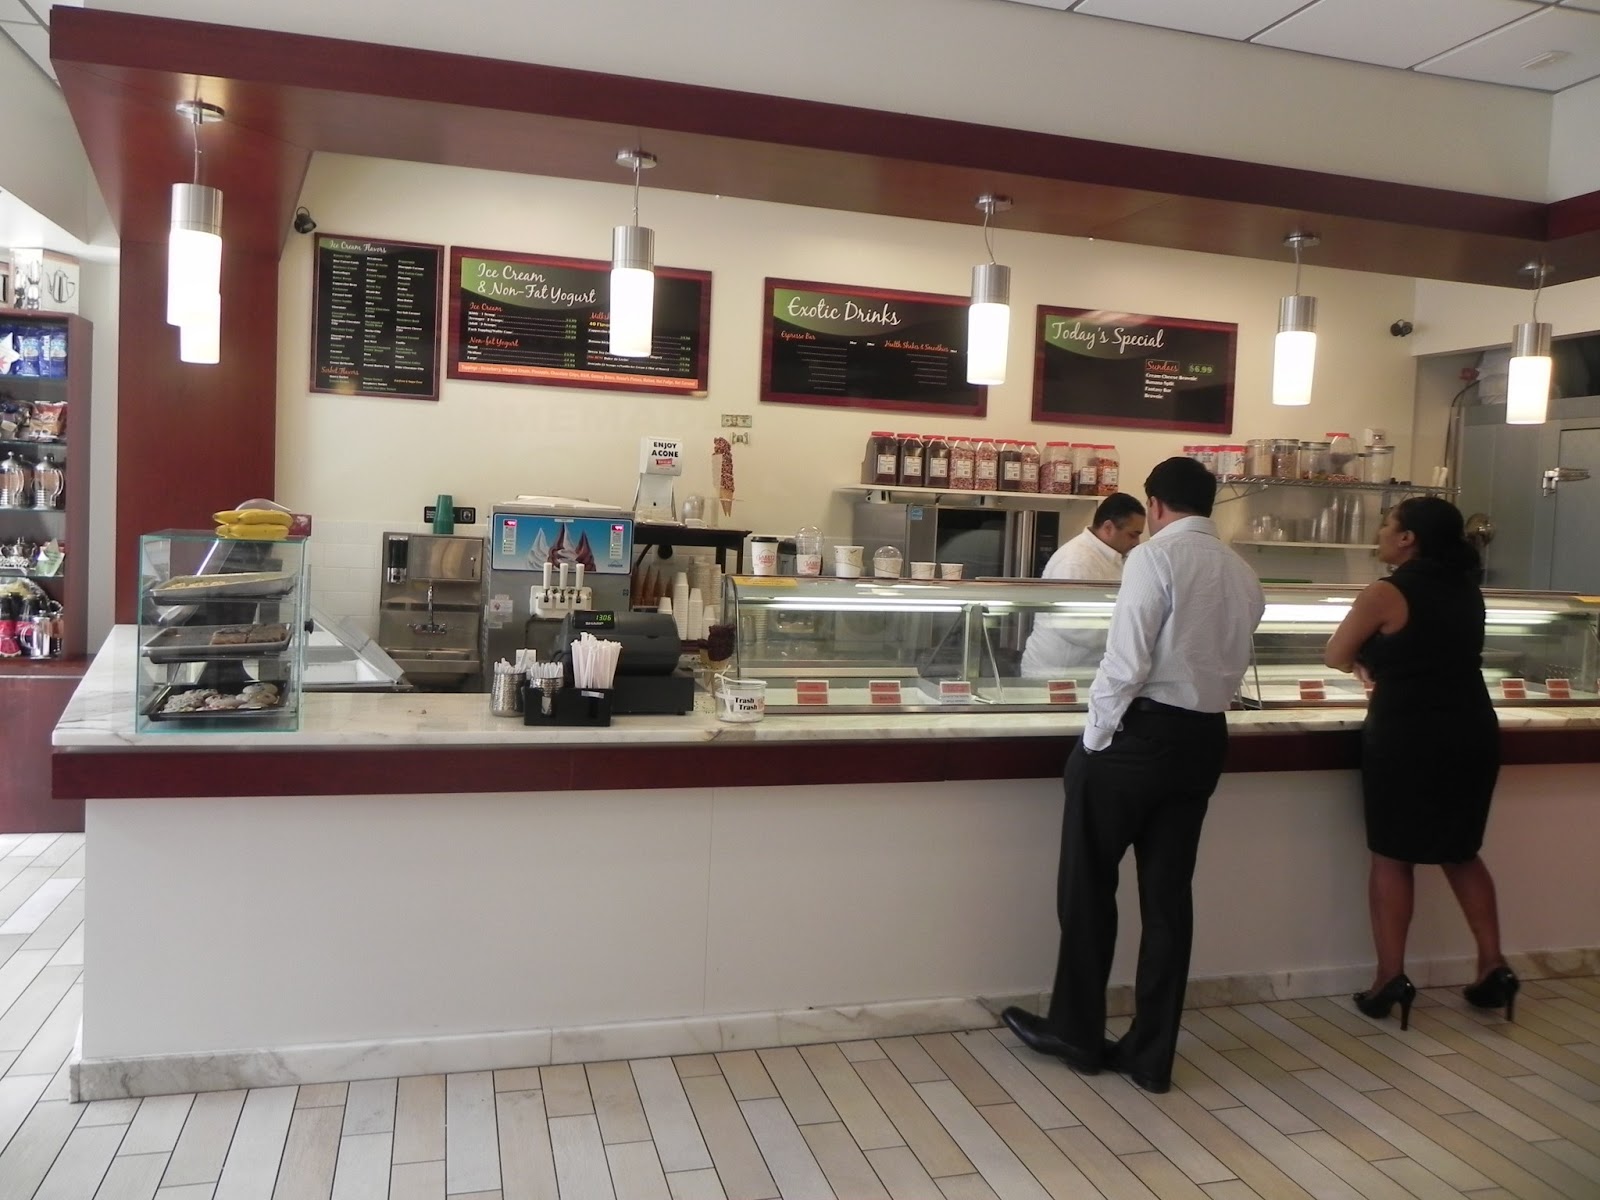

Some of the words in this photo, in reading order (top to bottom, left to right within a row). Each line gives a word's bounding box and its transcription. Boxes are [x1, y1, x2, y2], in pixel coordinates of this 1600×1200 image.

[330, 240, 338, 248] Ice
[341, 242, 361, 251] Cream
[363, 244, 387, 253] Flavors
[477, 263, 499, 277] Ice
[502, 265, 546, 282] Cream
[477, 281, 486, 293] &
[489, 282, 549, 299] Non-Fat
[550, 287, 596, 307] Yogurt
[470, 302, 480, 310] Ice
[481, 303, 502, 312] Cream
[787, 296, 841, 318] Exotic
[844, 300, 901, 326] Drinks
[781, 330, 804, 341] Espresso
[805, 332, 816, 340] Bar
[1052, 322, 1109, 350] Today's
[1111, 328, 1164, 354] Special
[496, 339, 519, 348] Yogurt
[884, 340, 902, 348] Health
[902, 342, 920, 350] Shakes
[925, 344, 949, 352] Smoothies
[1147, 360, 1179, 372] Sundaes
[1189, 364, 1212, 373] $6.99
[658, 450, 678, 458] CONE
